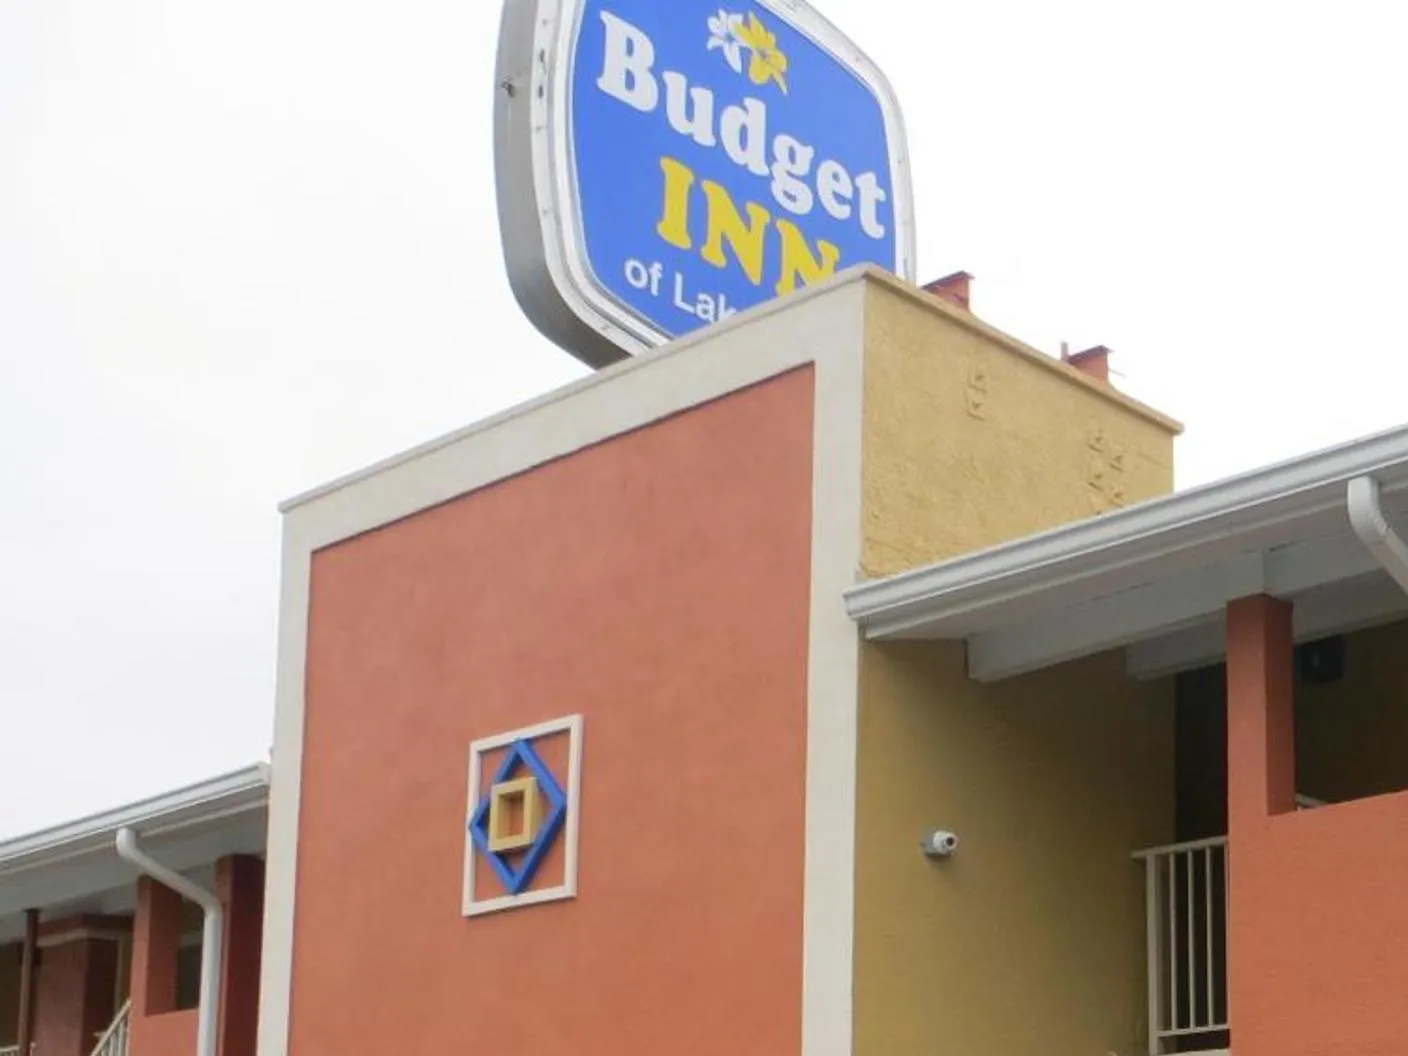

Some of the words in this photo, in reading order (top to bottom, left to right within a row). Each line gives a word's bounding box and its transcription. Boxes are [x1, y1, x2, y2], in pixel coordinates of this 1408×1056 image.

[597, 10, 887, 239] Budget
[623, 258, 664, 297] of
[656, 156, 840, 298] INN
